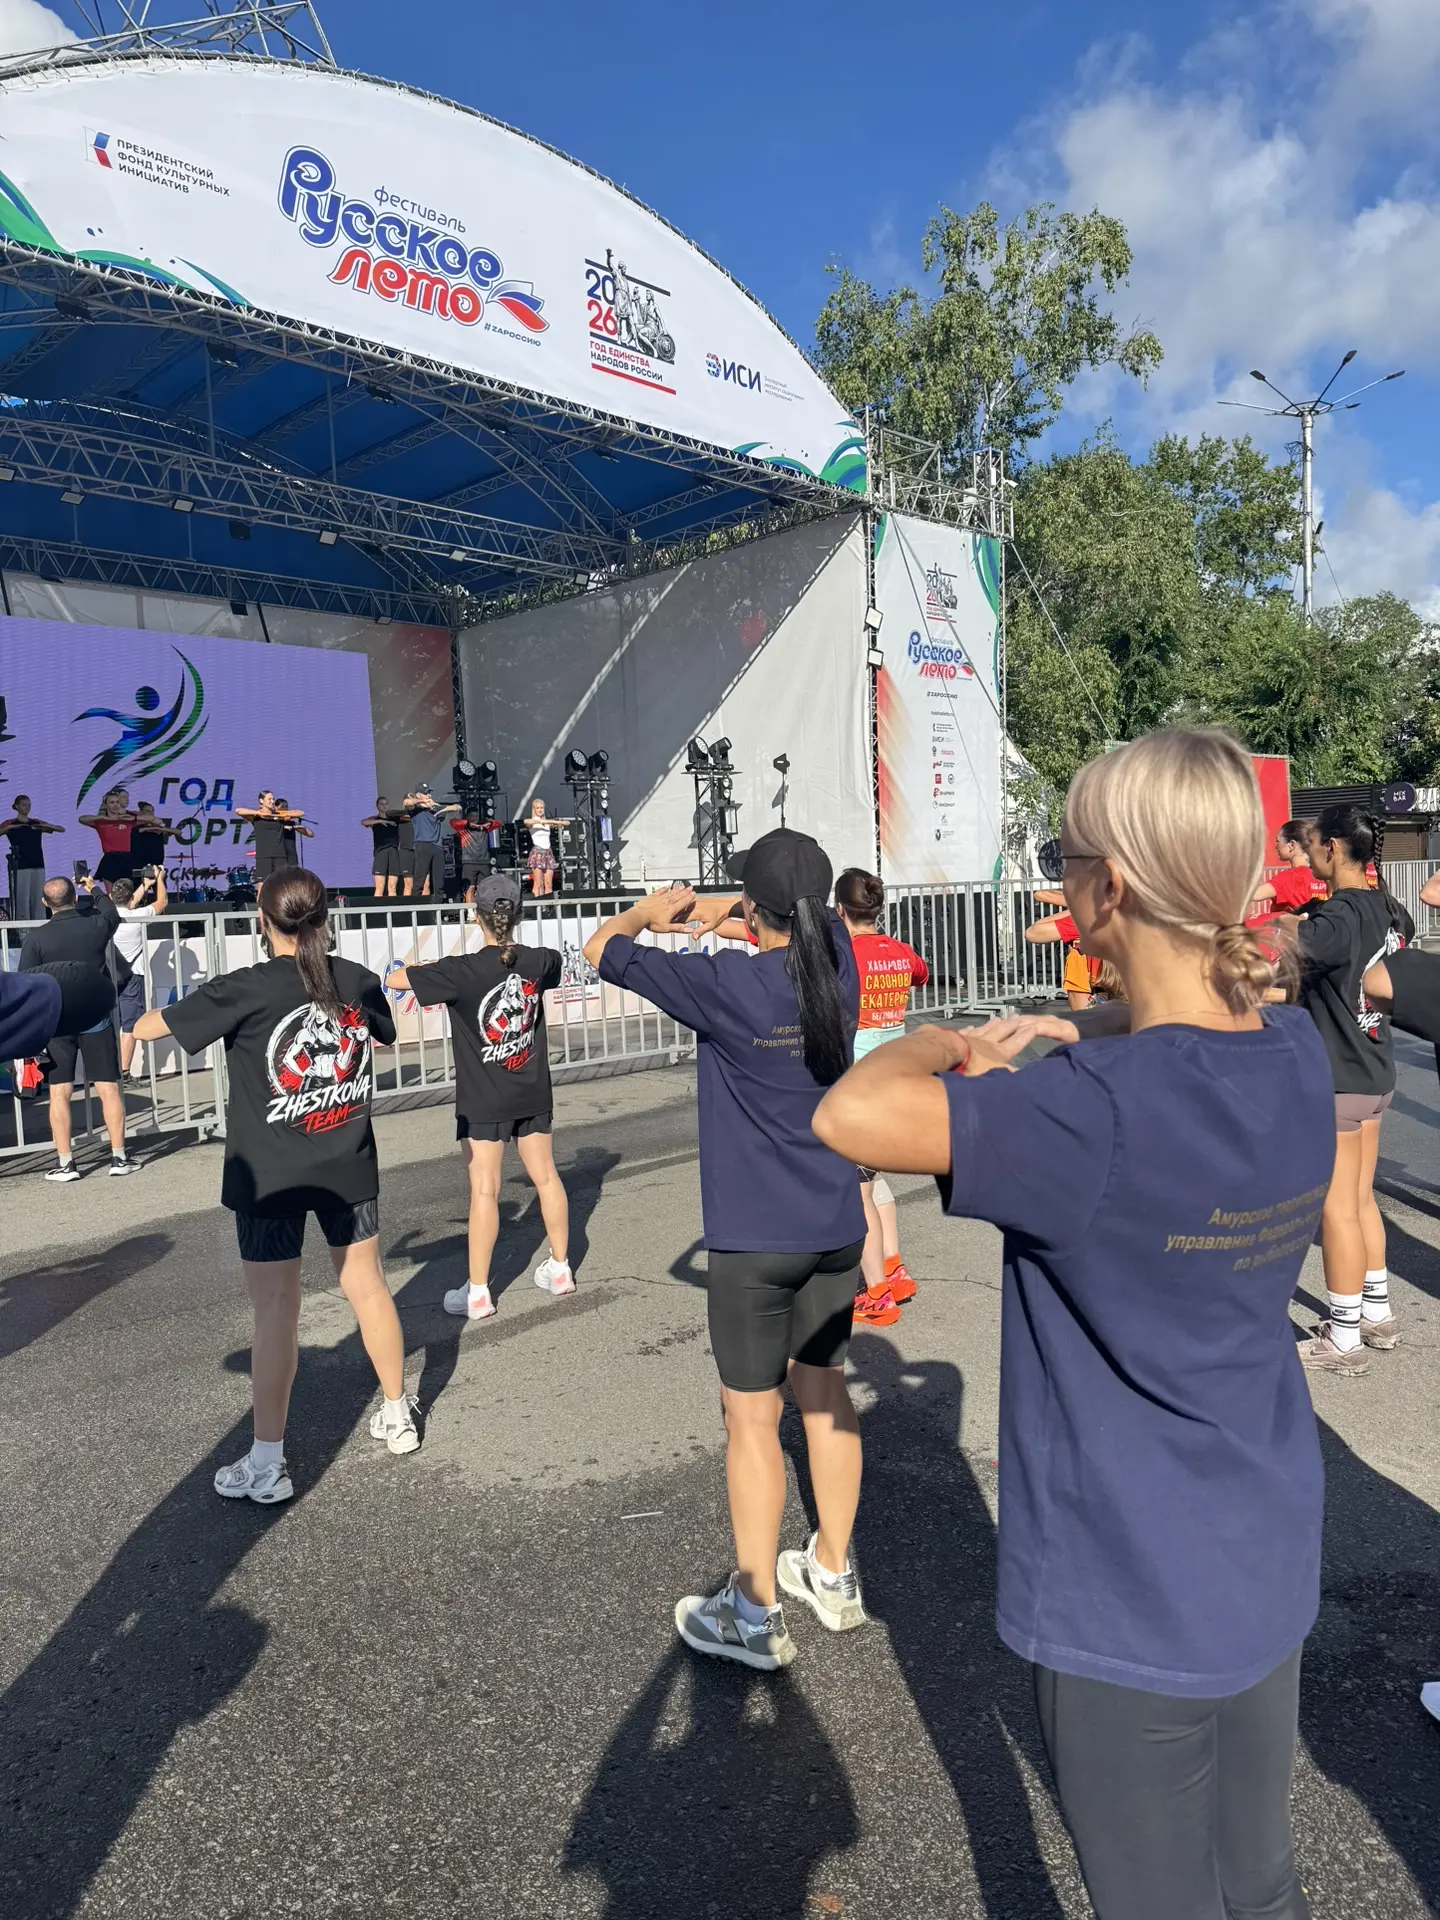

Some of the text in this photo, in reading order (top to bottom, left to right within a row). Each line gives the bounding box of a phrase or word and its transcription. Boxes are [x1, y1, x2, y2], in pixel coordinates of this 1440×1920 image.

[117, 138, 214, 180] ПРЕЗИДЕНТСКИЙ
[117, 151, 231, 196] ФОНД КУЛЬТУРНЫХ
[118, 162, 190, 194] ИНИЦИАТИВ
[278, 146, 502, 289] Русское
[374, 185, 466, 233] фестиваль
[585, 268, 617, 306] 20
[587, 299, 618, 336] 26
[589, 340, 650, 368] ГОД ЕДИНСТВА
[590, 351, 663, 382] НАРОДОВ РОССИИ
[908, 631, 963, 664] Русское
[159, 777, 235, 811] ГОД
[266, 1075, 372, 1124] ZHESTKOVA
[304, 1103, 349, 1133] TEAM
